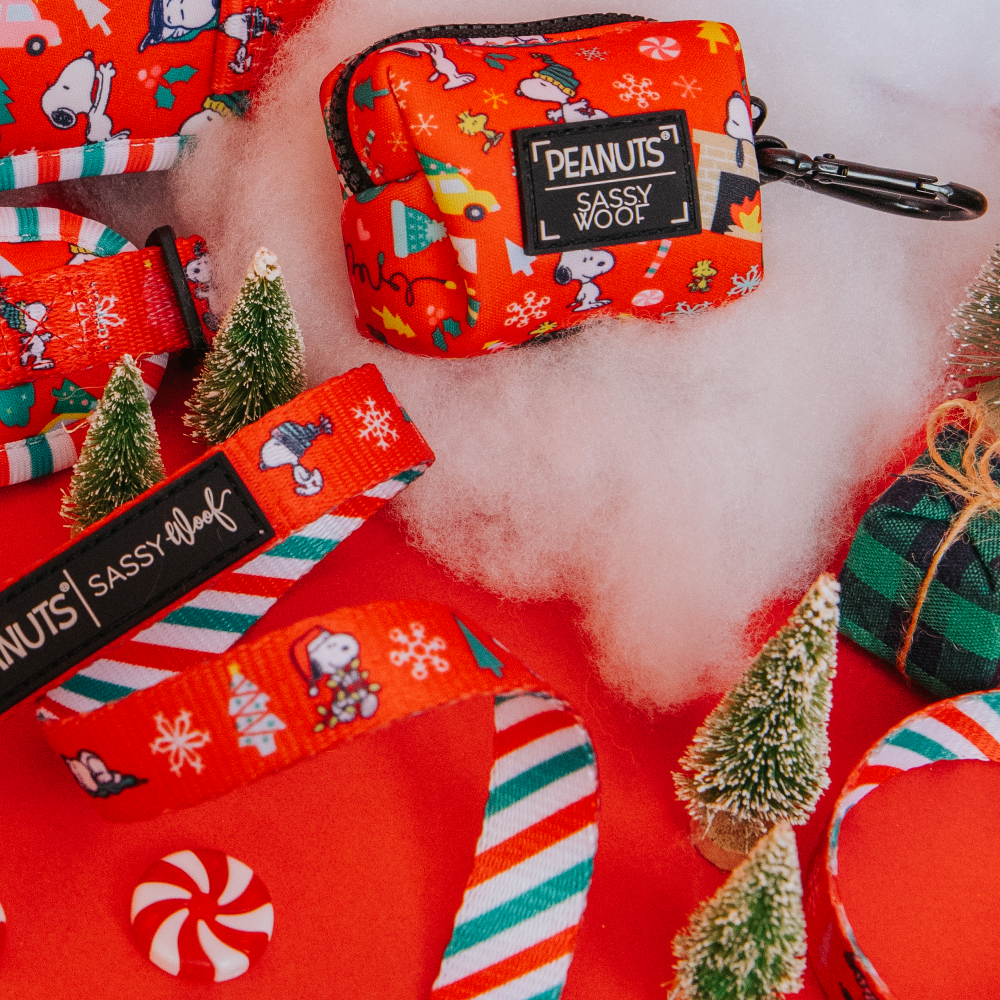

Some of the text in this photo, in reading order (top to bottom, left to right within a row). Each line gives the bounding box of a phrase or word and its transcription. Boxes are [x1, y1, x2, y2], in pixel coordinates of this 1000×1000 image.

[576, 183, 653, 213] SASSY
[572, 202, 650, 231] WOOF
[87, 533, 165, 597] SASSY
[165, 486, 237, 546] Woof
